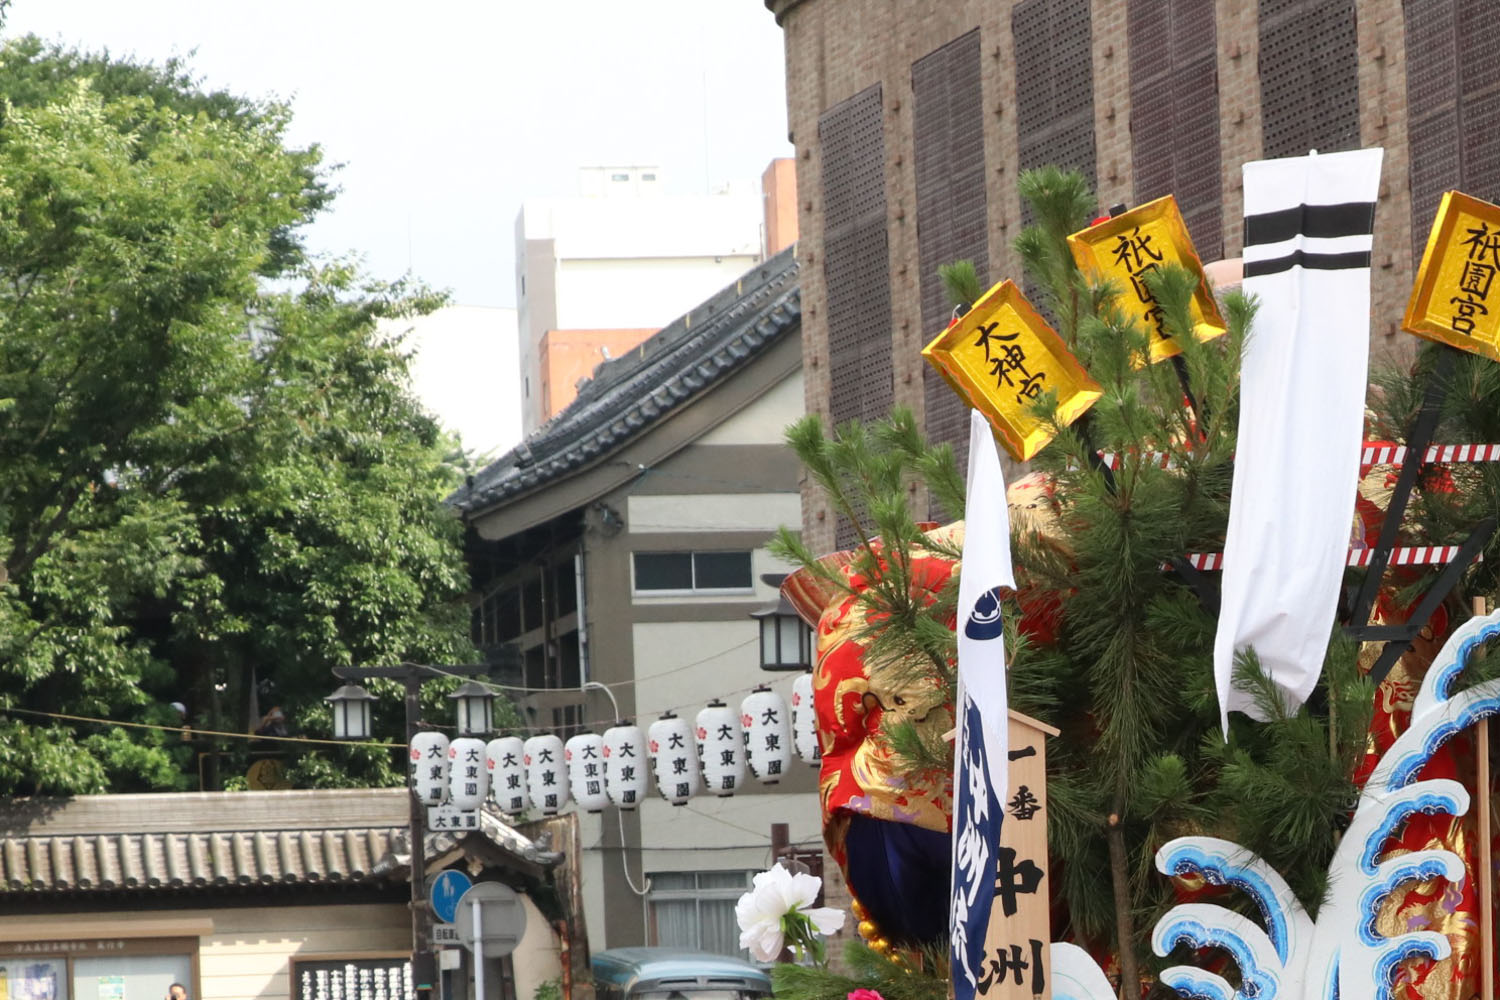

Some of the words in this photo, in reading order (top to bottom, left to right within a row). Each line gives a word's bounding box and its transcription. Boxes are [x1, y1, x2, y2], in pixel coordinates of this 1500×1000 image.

[583, 745, 600, 795] 大東園
[669, 733, 689, 797] 大東園
[718, 725, 735, 789] 大東園
[762, 708, 781, 775] 大東園
[428, 744, 443, 799] 大東園
[465, 749, 479, 796] 大東園
[503, 753, 523, 809] 大東園
[539, 749, 557, 808] 大東園
[620, 743, 636, 803] 大東園
[436, 816, 476, 827] 大東園
